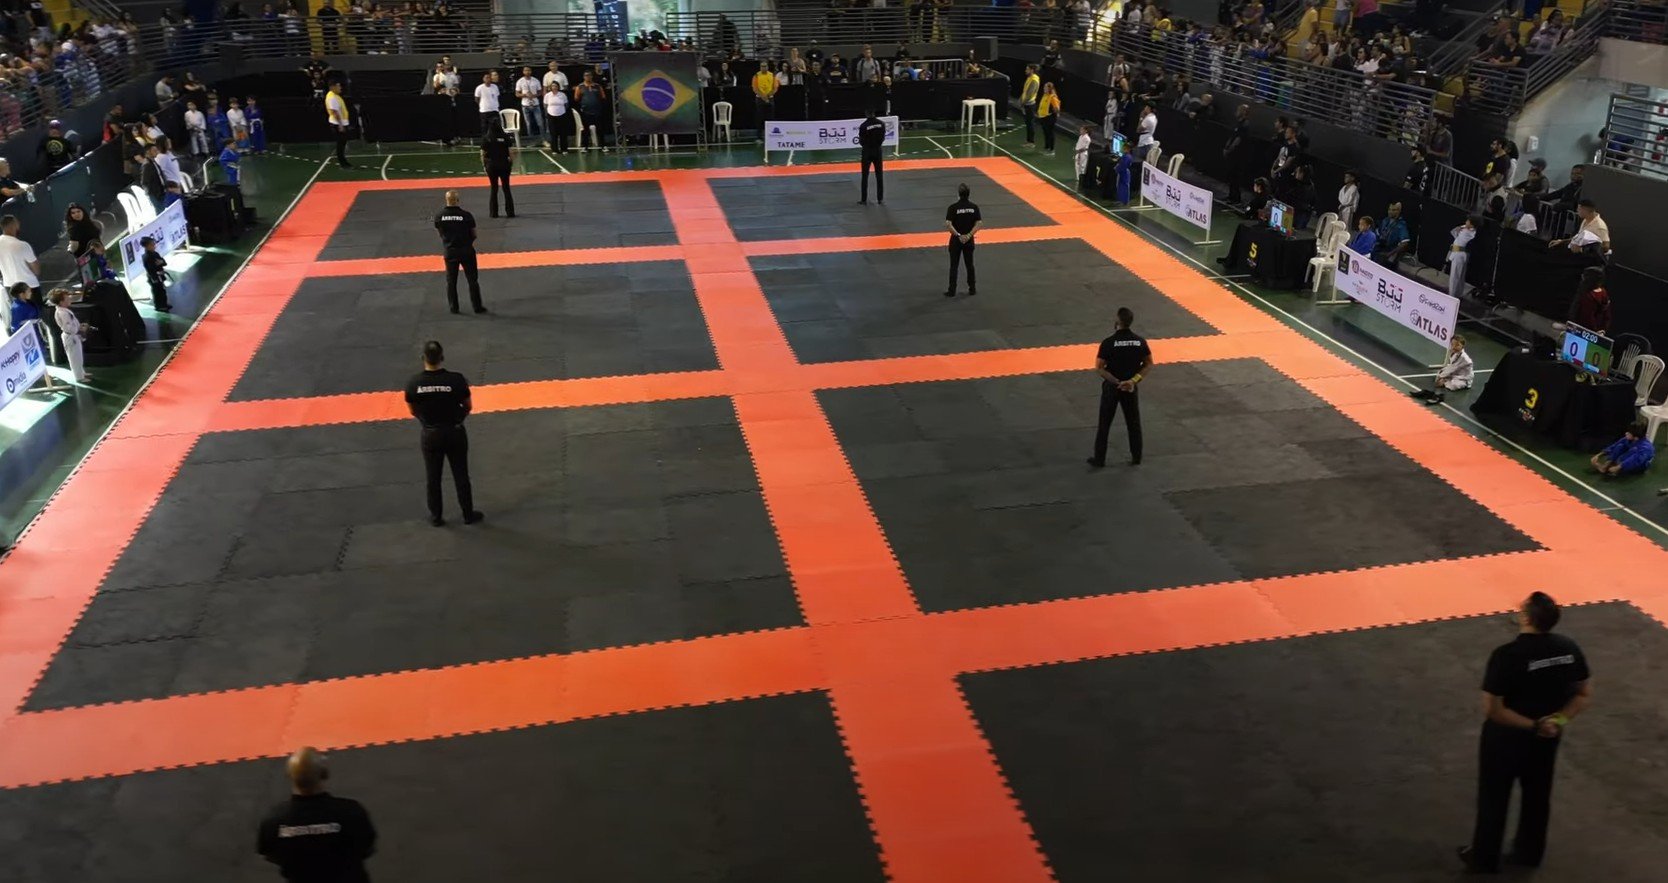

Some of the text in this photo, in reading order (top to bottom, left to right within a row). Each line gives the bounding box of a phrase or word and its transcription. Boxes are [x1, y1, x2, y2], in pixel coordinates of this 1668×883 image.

[819, 128, 846, 137] BJJ
[1166, 185, 1181, 202] BJJ
[1187, 208, 1207, 225] ATLAS
[1249, 242, 1258, 258] 5
[1377, 278, 1403, 304] BJJ
[1376, 292, 1402, 313] STORM
[1416, 315, 1448, 341] ATLAS
[1581, 330, 1599, 344] 02:00
[1570, 342, 1578, 357] 0
[1525, 388, 1538, 409] 3
